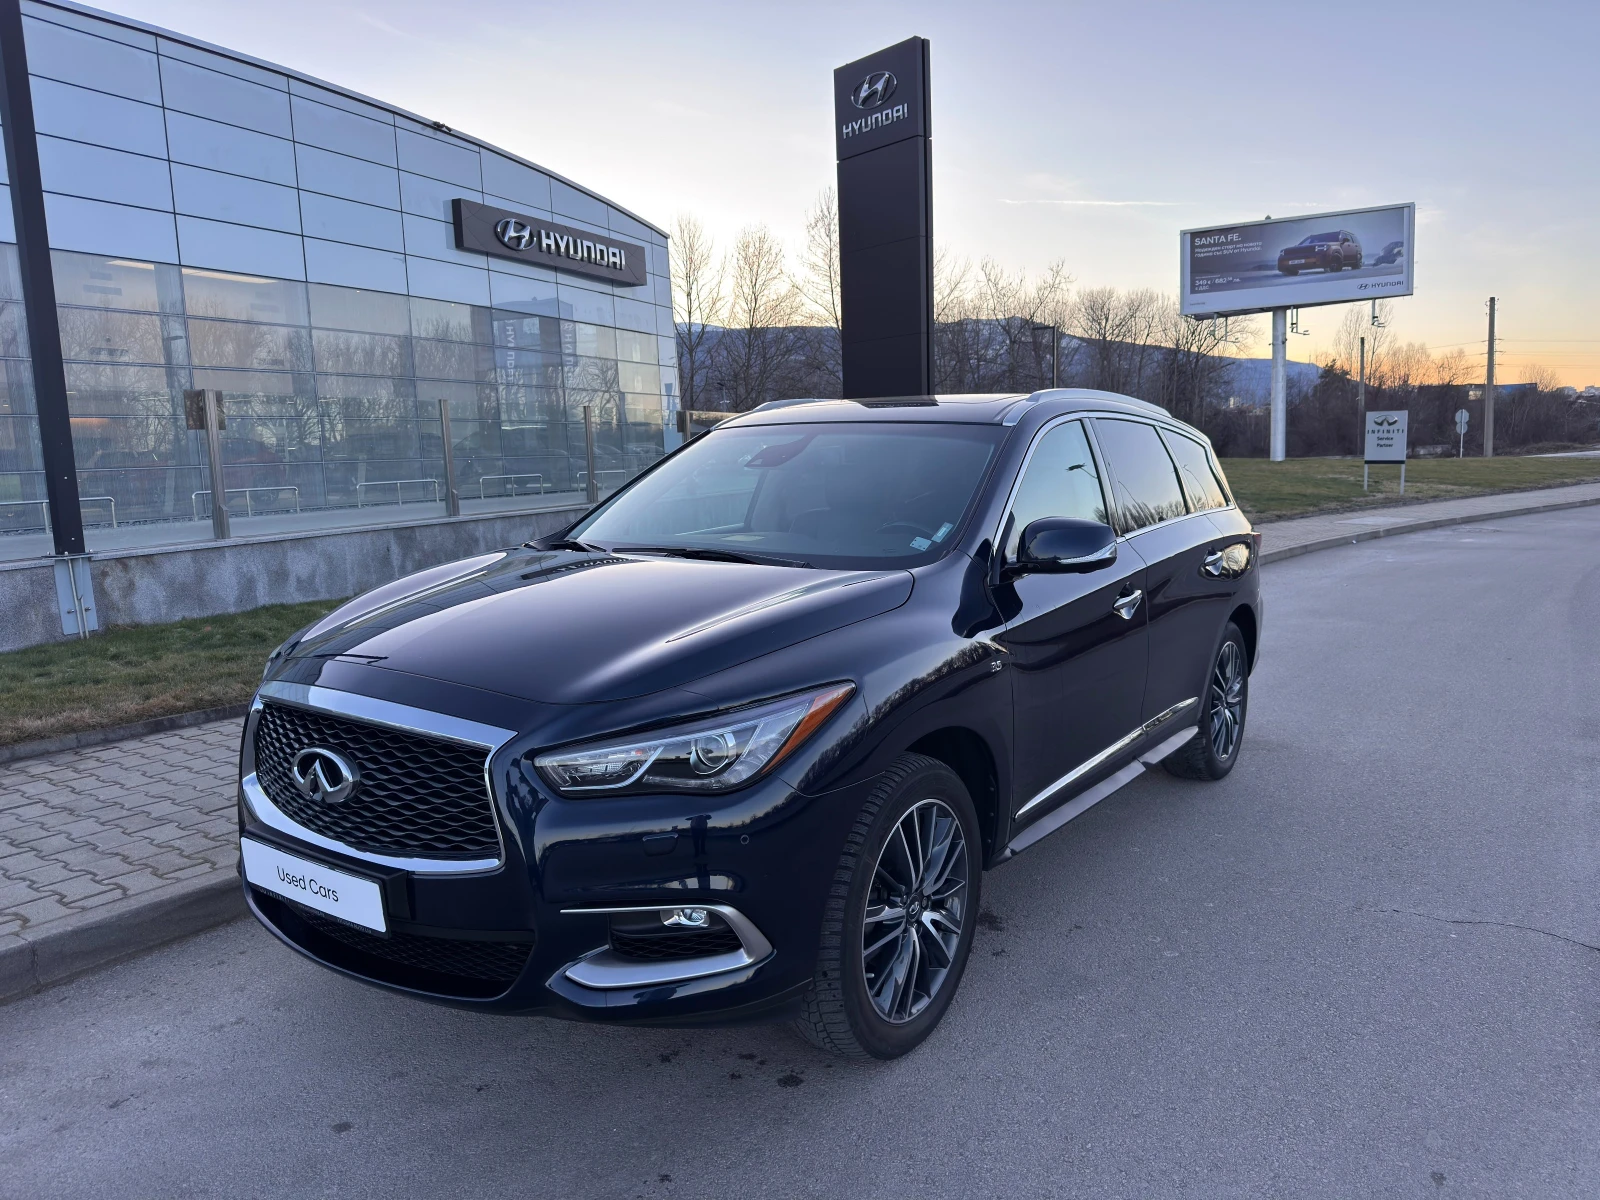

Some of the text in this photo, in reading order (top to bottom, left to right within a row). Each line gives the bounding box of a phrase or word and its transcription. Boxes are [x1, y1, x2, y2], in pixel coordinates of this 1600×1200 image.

[842, 103, 908, 139] HYUNDAI
[540, 229, 626, 270] HYUNDAI
[1194, 233, 1242, 246] SANTA FE.
[1371, 280, 1404, 289] HYUNDAI
[276, 865, 307, 891] Used
[309, 879, 339, 902] Cars
